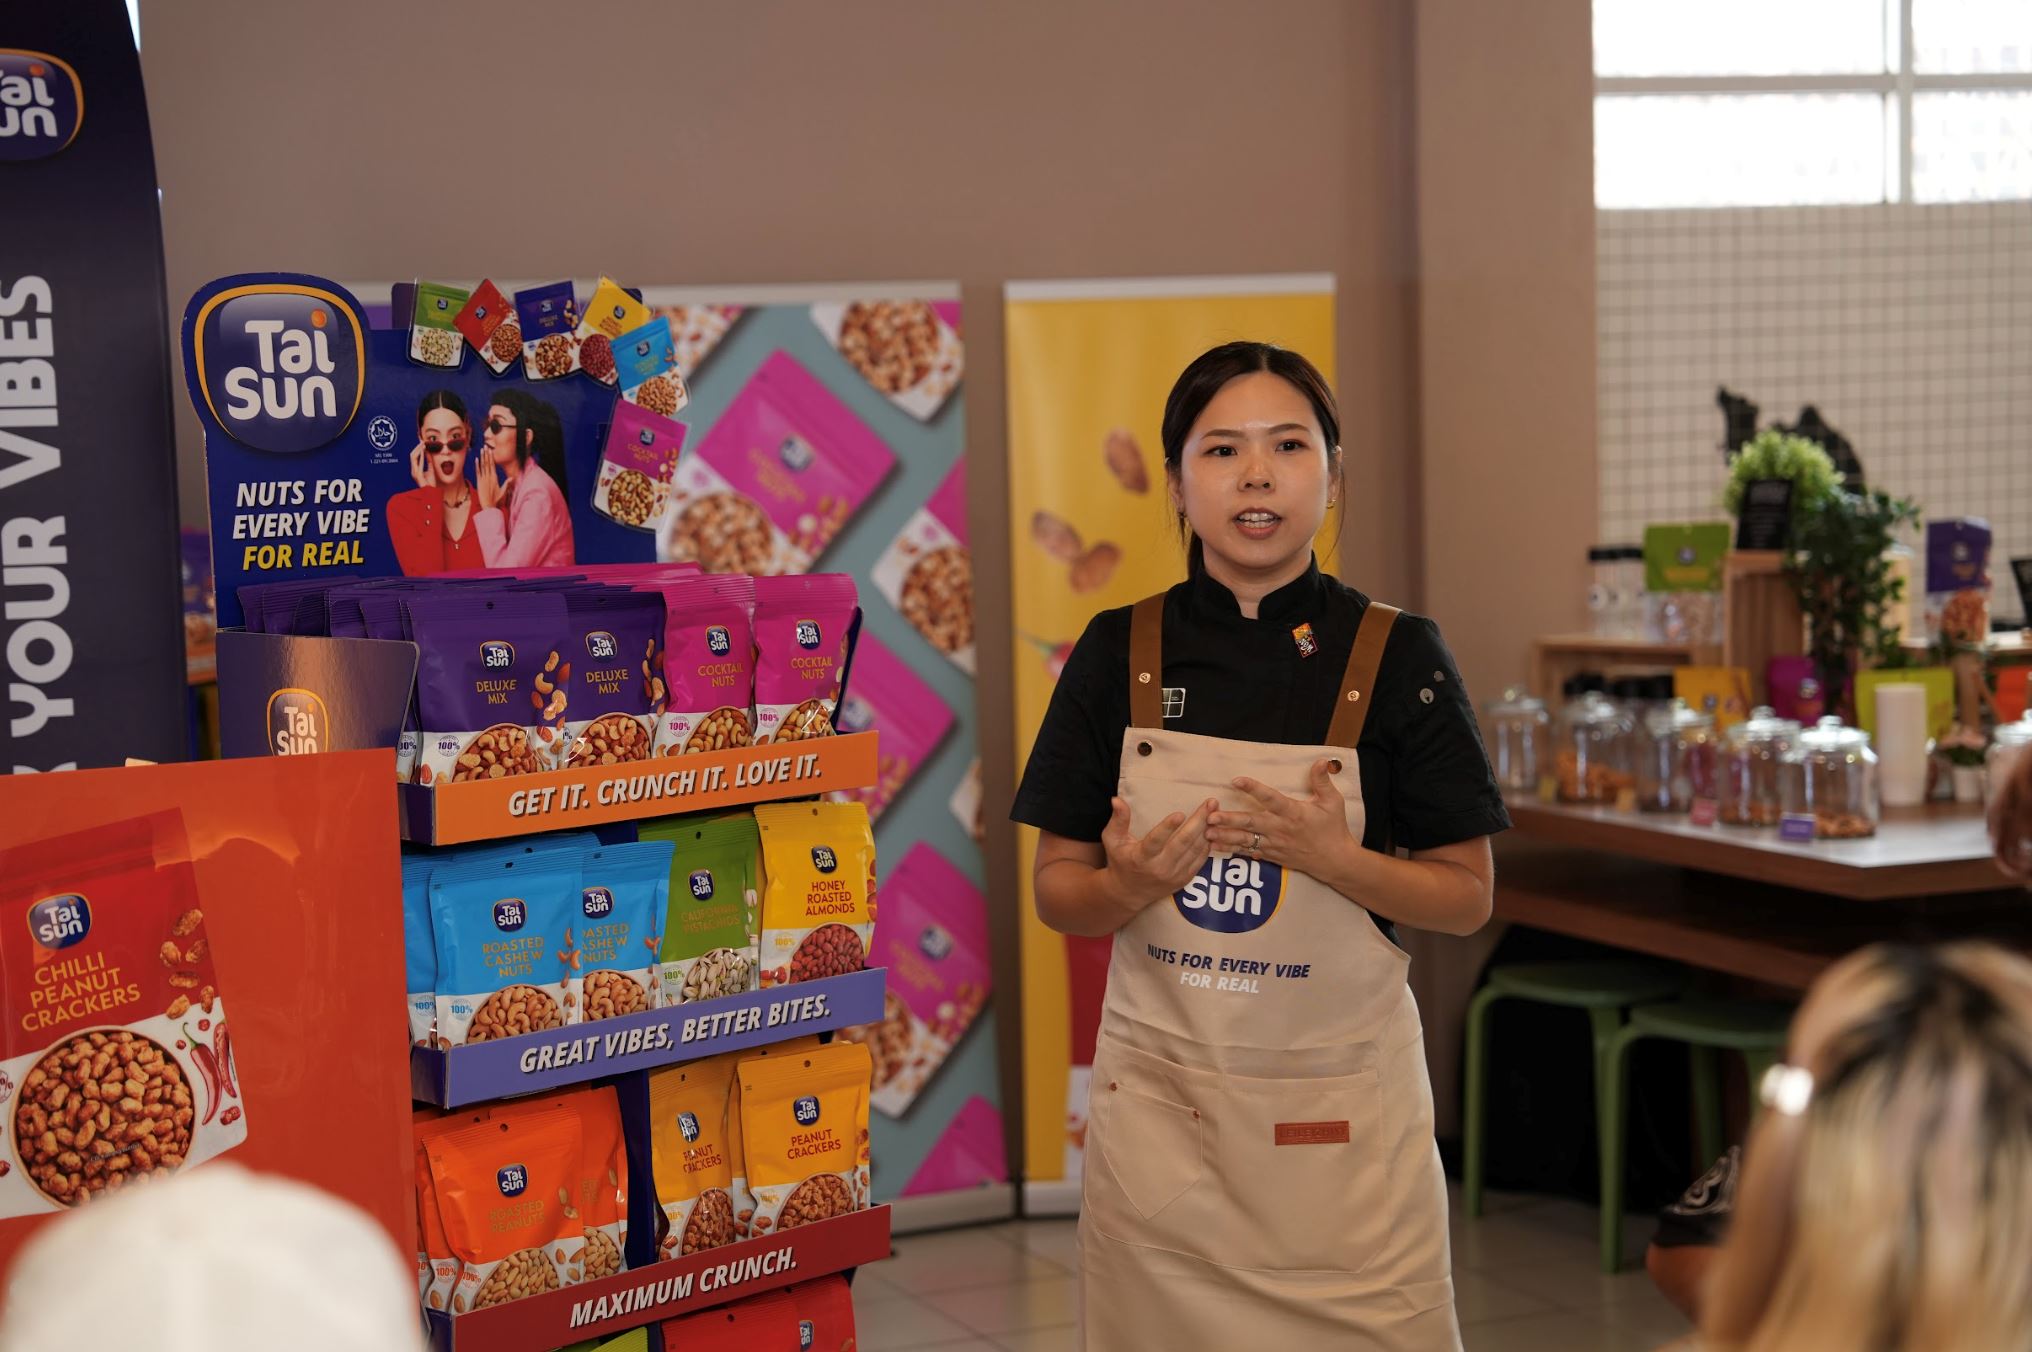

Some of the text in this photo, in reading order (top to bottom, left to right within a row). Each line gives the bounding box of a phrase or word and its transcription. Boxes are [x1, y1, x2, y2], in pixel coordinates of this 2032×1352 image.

[0, 63, 54, 107] ai
[0, 106, 58, 137] un
[245, 309, 336, 374] Tai
[0, 275, 62, 489] VIBES
[224, 366, 337, 421] Sun
[236, 478, 363, 507] NUTS FOR
[232, 508, 370, 539] EVERY VIBE
[243, 540, 364, 571] FOR REAL
[1, 515, 75, 738] YOUR
[802, 624, 817, 635] Tai
[594, 636, 611, 648] Tai
[711, 629, 727, 642] Tai
[800, 634, 819, 645] Sun
[489, 645, 509, 657] Tai
[592, 646, 614, 657] Sun
[710, 640, 728, 651] Sun
[486, 656, 509, 667] Sun
[791, 657, 833, 669] COCKTAIL
[586, 669, 629, 683] DELUXE
[698, 663, 744, 677] COCKTAIL
[801, 669, 825, 680] NUTS
[476, 679, 517, 693] DELUXE
[711, 675, 735, 687] NUTS
[598, 682, 620, 695] MIX
[488, 692, 508, 704] MIX
[284, 703, 317, 738] Tai
[759, 713, 779, 722] 100%
[669, 722, 690, 731] 100%
[276, 729, 318, 757] Sun
[438, 741, 460, 750] 100%
[508, 753, 821, 817] GET IT. CRUNCH IT. LOVE IT.
[816, 848, 832, 860] Tai
[815, 858, 835, 868] Sun
[1208, 850, 1264, 889] Tai
[694, 873, 710, 886] Tai
[812, 880, 846, 892] HONEY
[693, 883, 711, 896] Sun
[1182, 875, 1262, 916] Sun
[588, 891, 607, 903] Tai
[807, 892, 852, 904] ROASTED
[44, 898, 80, 924] Tai
[502, 902, 521, 916] Tai
[585, 902, 609, 913] Sun
[805, 903, 855, 916] ALMONDS
[498, 914, 522, 926] Sun
[39, 920, 83, 942] Sun
[583, 923, 630, 938] ASTED
[482, 937, 545, 954] ROASTED
[484, 950, 543, 968] CASHEW
[1147, 943, 1311, 978] NUTS FOR EVERY VIBE
[35, 951, 105, 985] CHILLI
[499, 964, 532, 977] NUTS
[30, 967, 121, 1009] PEANUT
[1180, 971, 1259, 994] FOR REAL
[22, 983, 141, 1031] CRACKERS
[451, 1005, 473, 1014] 100%
[519, 993, 831, 1074] GREAT VIBES, BETTER BITES.
[802, 1100, 816, 1113] Tai
[797, 1110, 817, 1121] Sun
[791, 1129, 833, 1147] PEANUT
[787, 1139, 842, 1160] CRACKERS
[504, 1168, 523, 1182] Tai
[502, 1180, 524, 1192] Sun
[436, 1266, 456, 1277] 100%
[569, 1246, 797, 1328] MAXIMUM CRUNCH.
